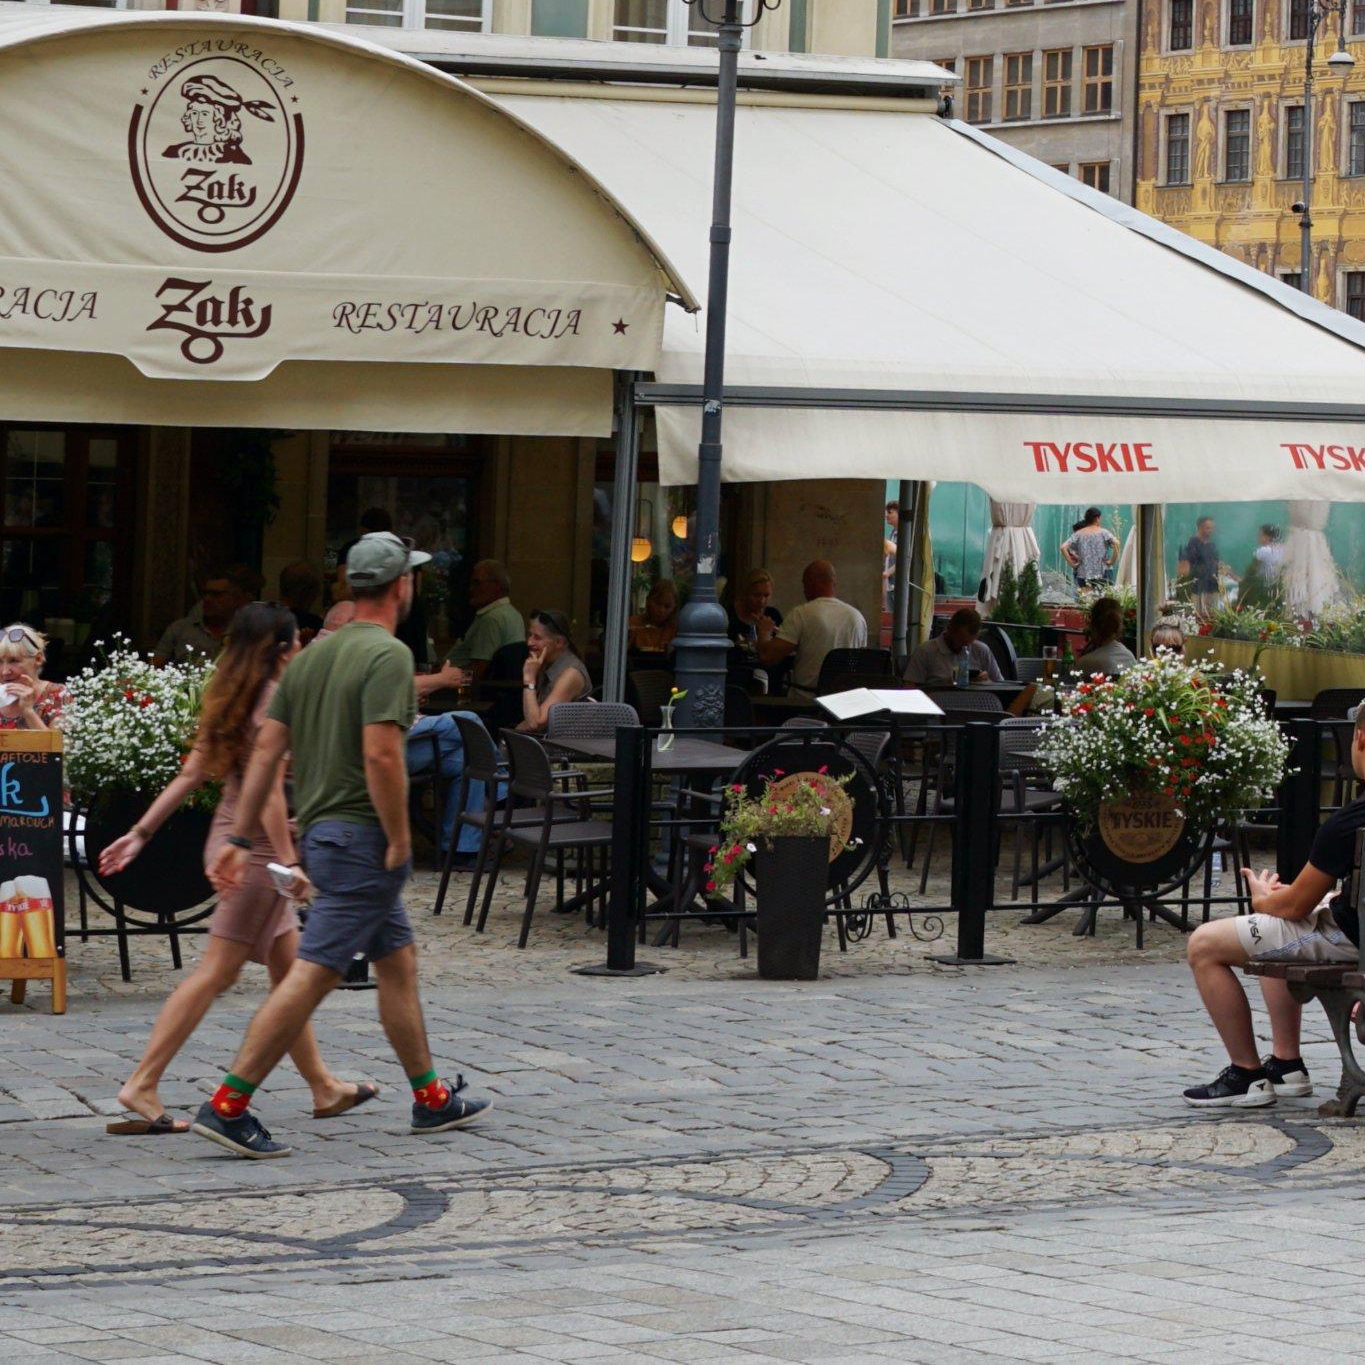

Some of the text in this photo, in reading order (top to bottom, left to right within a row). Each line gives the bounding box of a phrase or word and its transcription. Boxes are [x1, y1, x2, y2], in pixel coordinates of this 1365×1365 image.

[149, 40, 294, 89] RESTAURACJA
[332, 301, 582, 338] RESTAURACJA
[1023, 442, 1159, 472] TYSKIE
